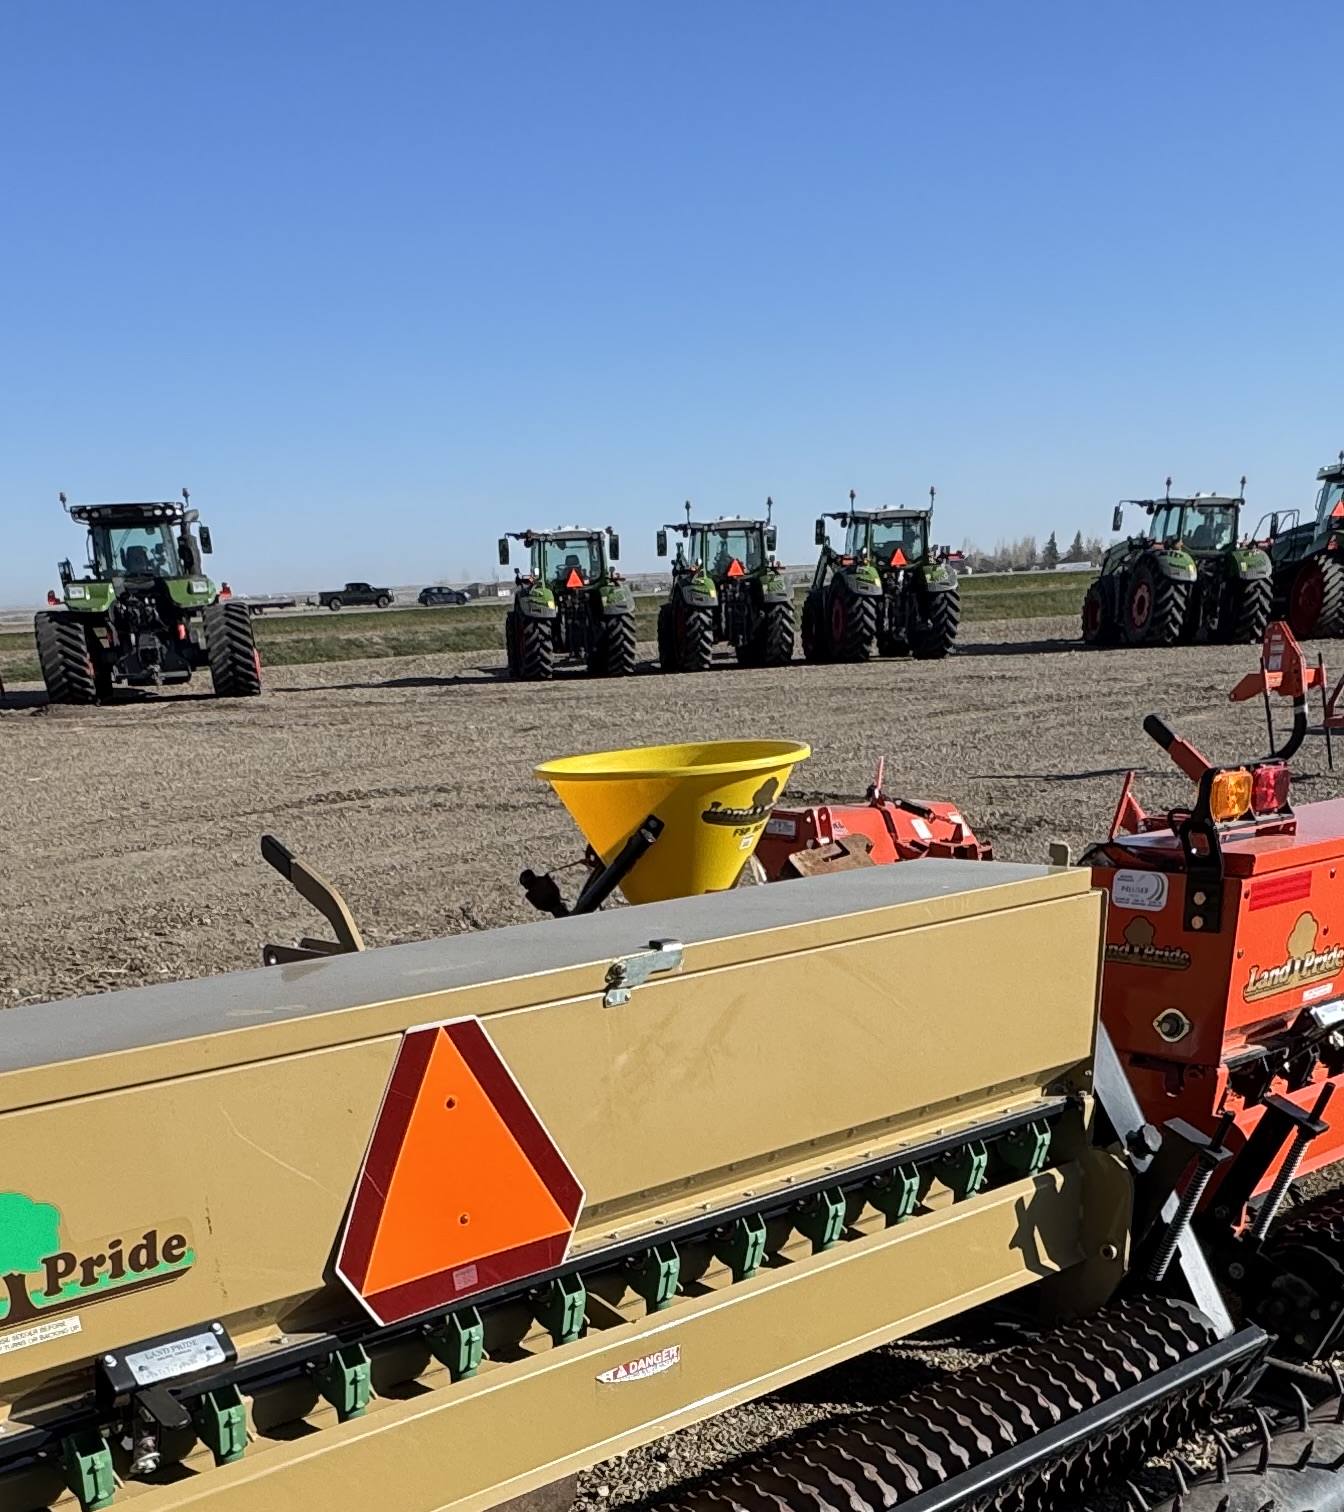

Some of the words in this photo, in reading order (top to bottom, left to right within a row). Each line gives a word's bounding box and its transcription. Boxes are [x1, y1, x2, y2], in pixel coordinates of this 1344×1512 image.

[1245, 956, 1292, 992] Land
[1300, 944, 1344, 980] Pride
[42, 1229, 187, 1297] Pride
[145, 1346, 171, 1360] LAND
[171, 1339, 199, 1352] PRIDE
[629, 1347, 677, 1373] DANGER
